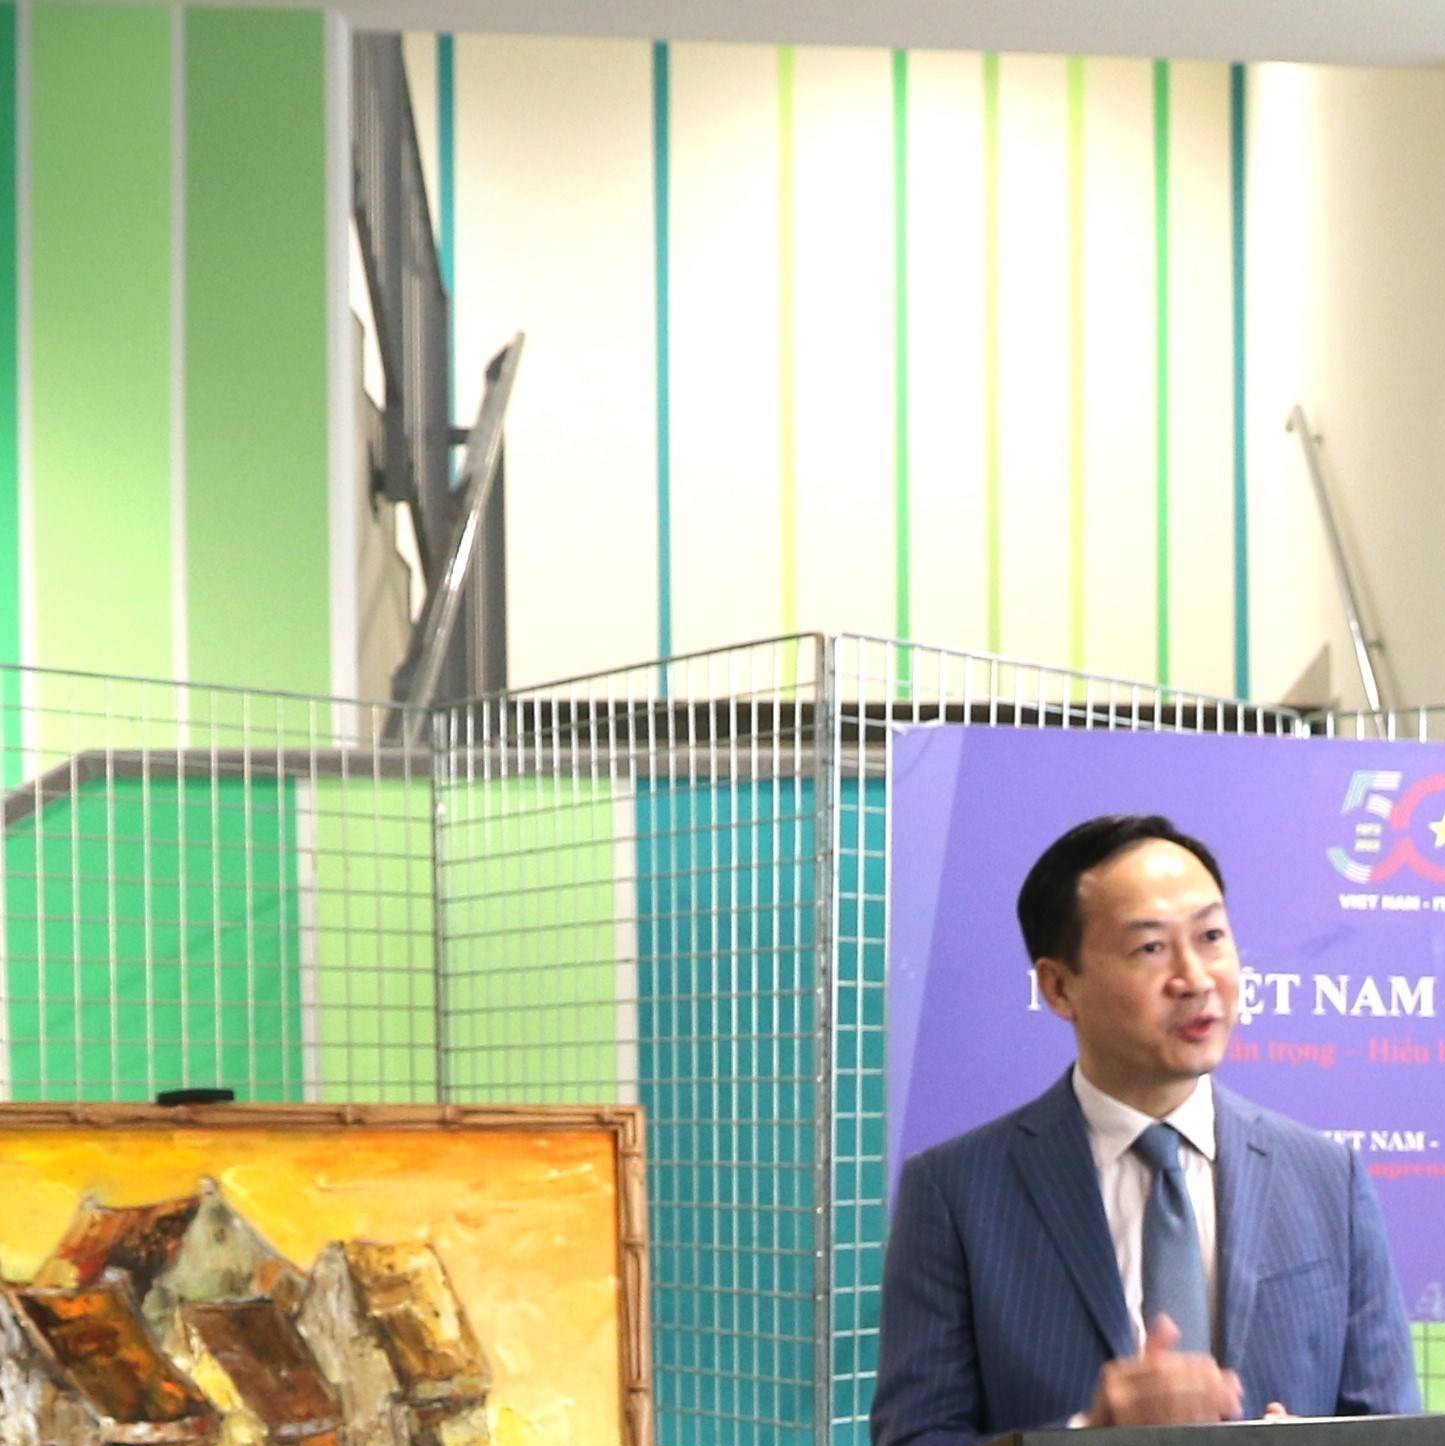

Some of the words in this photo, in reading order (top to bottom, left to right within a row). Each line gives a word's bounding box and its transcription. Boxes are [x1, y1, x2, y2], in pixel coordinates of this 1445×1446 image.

[1381, 894, 1422, 911] NAM
[1237, 966, 1301, 1025] ỆT
[1312, 973, 1436, 1018] NAM
[1370, 1130, 1426, 1152] NAM
